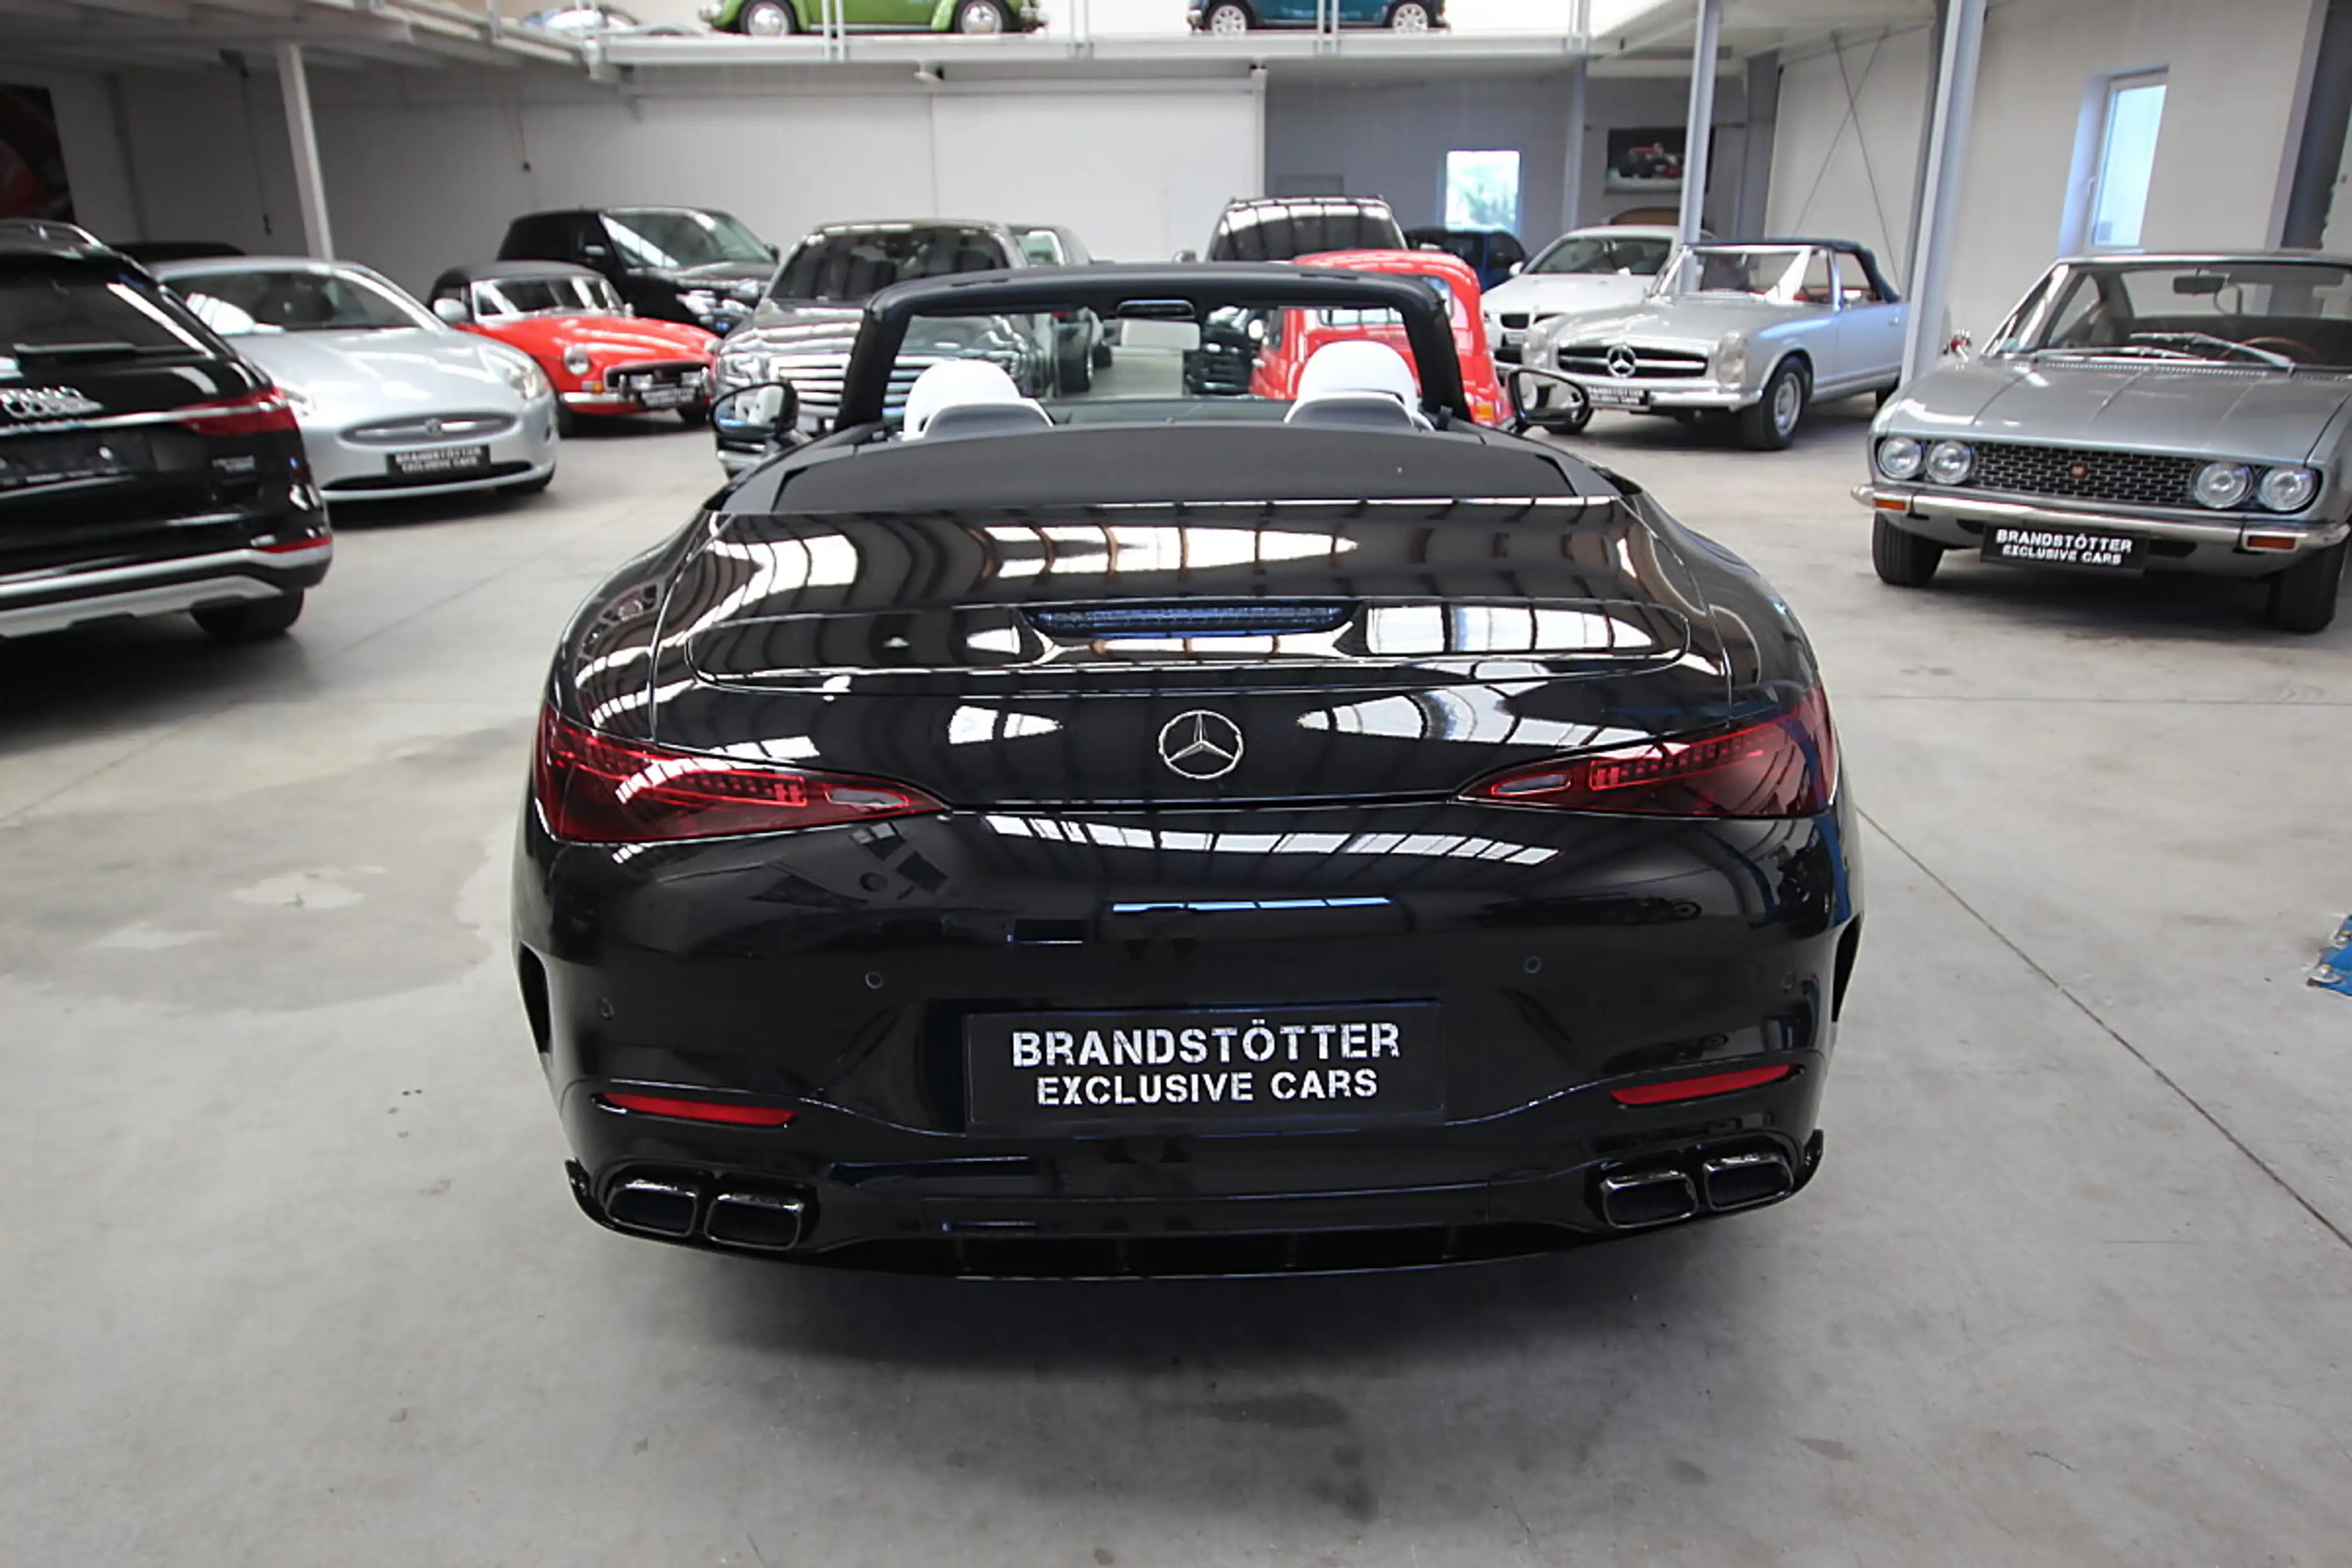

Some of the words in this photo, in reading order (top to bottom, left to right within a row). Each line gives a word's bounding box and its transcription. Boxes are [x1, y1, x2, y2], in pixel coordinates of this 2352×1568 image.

[1996, 529, 2133, 552] BRANDSTÖTTER
[2002, 544, 2077, 562] EXCLUSIVE
[2082, 551, 2122, 565] CARS
[1012, 1019, 1400, 1067] BRANDSTÖTTER
[1037, 1072, 1253, 1105] EXCLUSIVE
[1271, 1069, 1378, 1099] CARS
